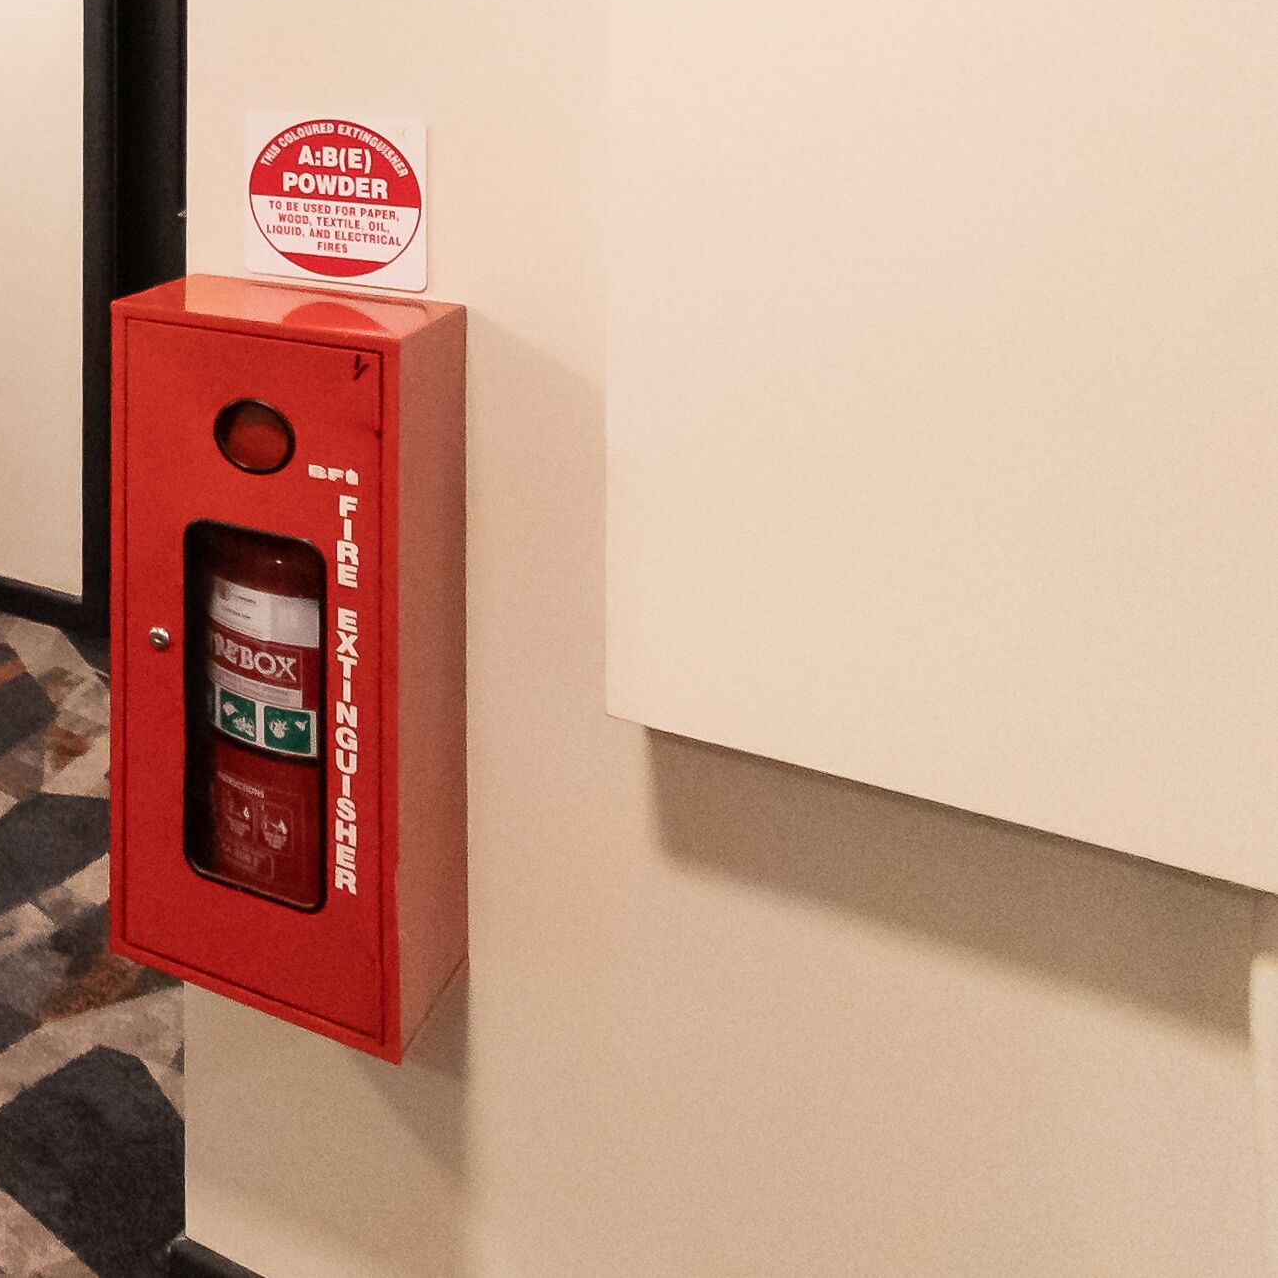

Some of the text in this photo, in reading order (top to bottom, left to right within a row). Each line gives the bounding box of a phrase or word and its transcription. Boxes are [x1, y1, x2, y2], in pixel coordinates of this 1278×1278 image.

[259, 123, 409, 178] THIS COLOURED EXTINGUISHER
[283, 172, 388, 199] POWDER
[269, 200, 400, 222] TO BE USED FOR PAPER,
[278, 213, 390, 233] WOOD, TEXTILE, OIL,
[266, 224, 402, 247] LIQUID, AND ELECTRICAL
[317, 242, 348, 253] FIRES
[334, 494, 359, 895] FIRE EXTINGUISHER
